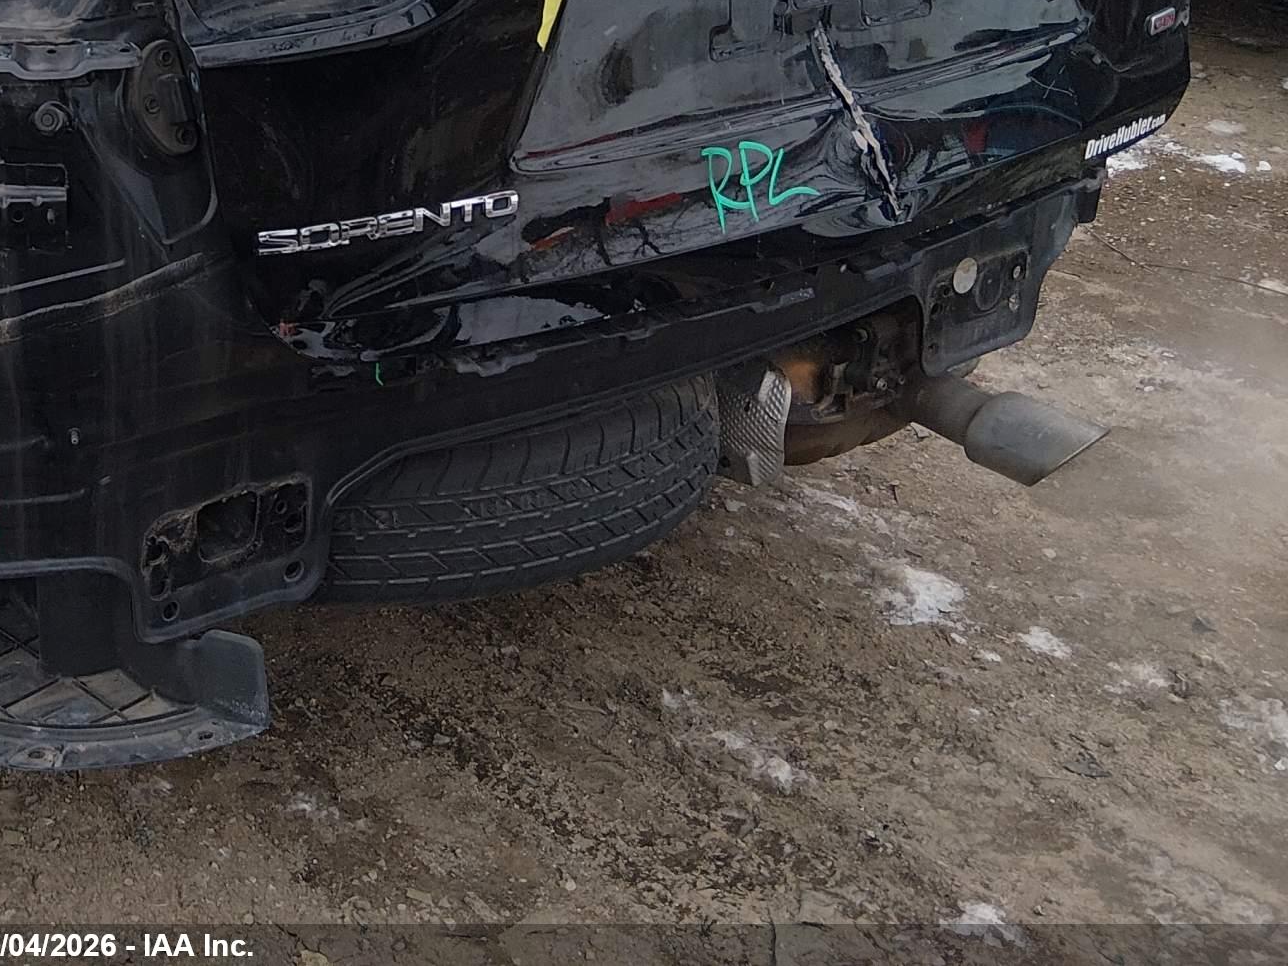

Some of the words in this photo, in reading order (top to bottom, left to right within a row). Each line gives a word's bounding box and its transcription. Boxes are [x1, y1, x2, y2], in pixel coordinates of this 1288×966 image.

[1084, 114, 1167, 161] DriveHubler.com
[701, 141, 821, 234] RPL
[258, 190, 519, 255] SORENTO
